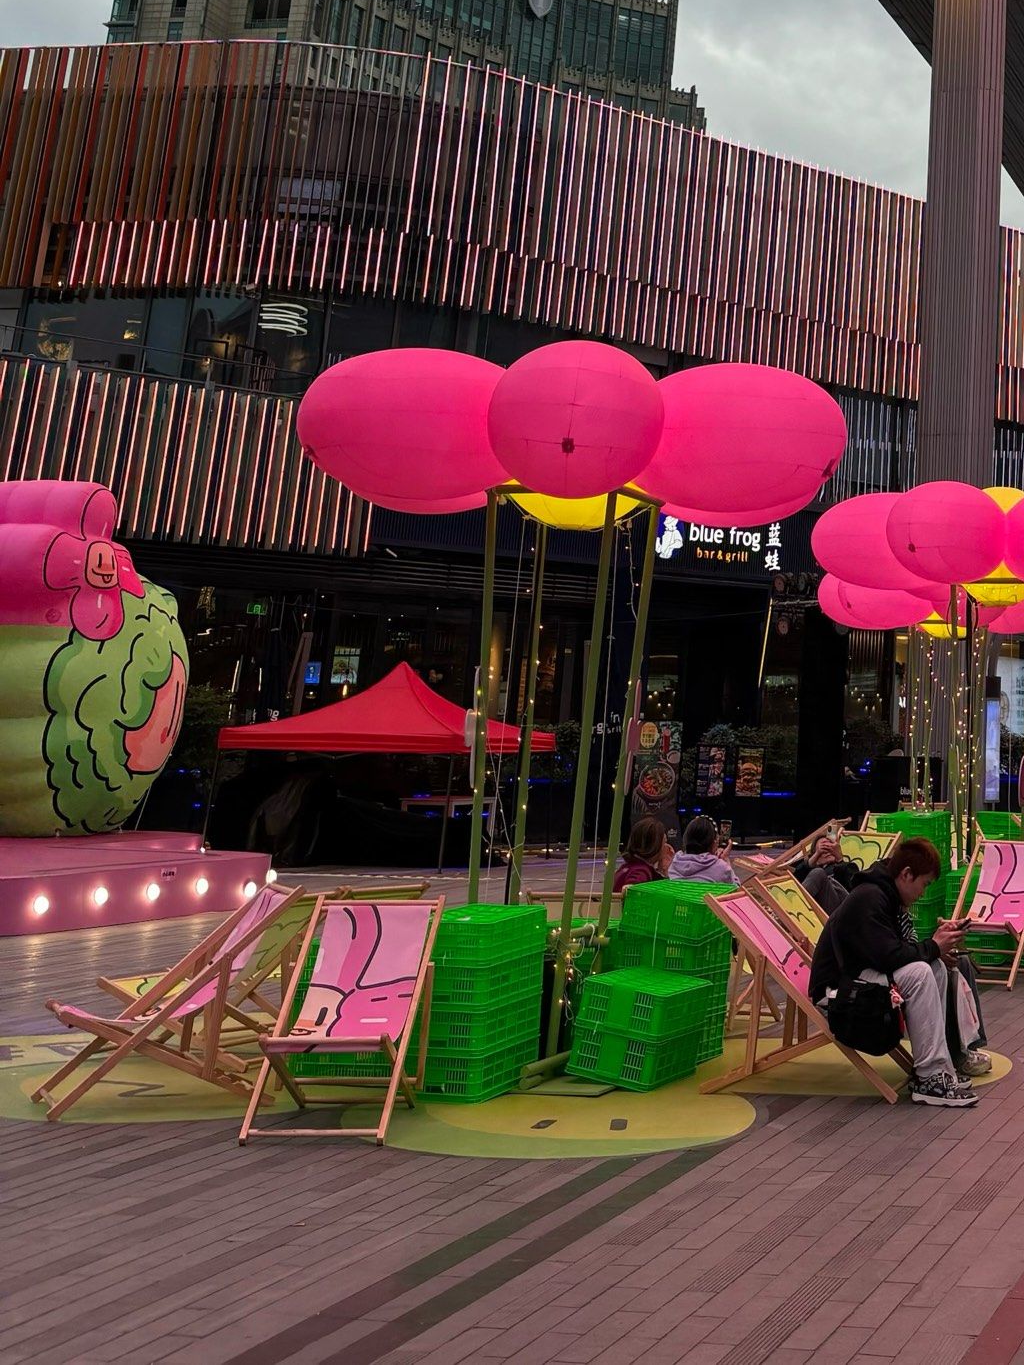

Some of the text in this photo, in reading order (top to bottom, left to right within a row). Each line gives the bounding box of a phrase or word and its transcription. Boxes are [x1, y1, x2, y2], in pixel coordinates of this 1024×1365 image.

[689, 522, 761, 552] blue frog
[764, 522, 781, 571] 蓝蛙
